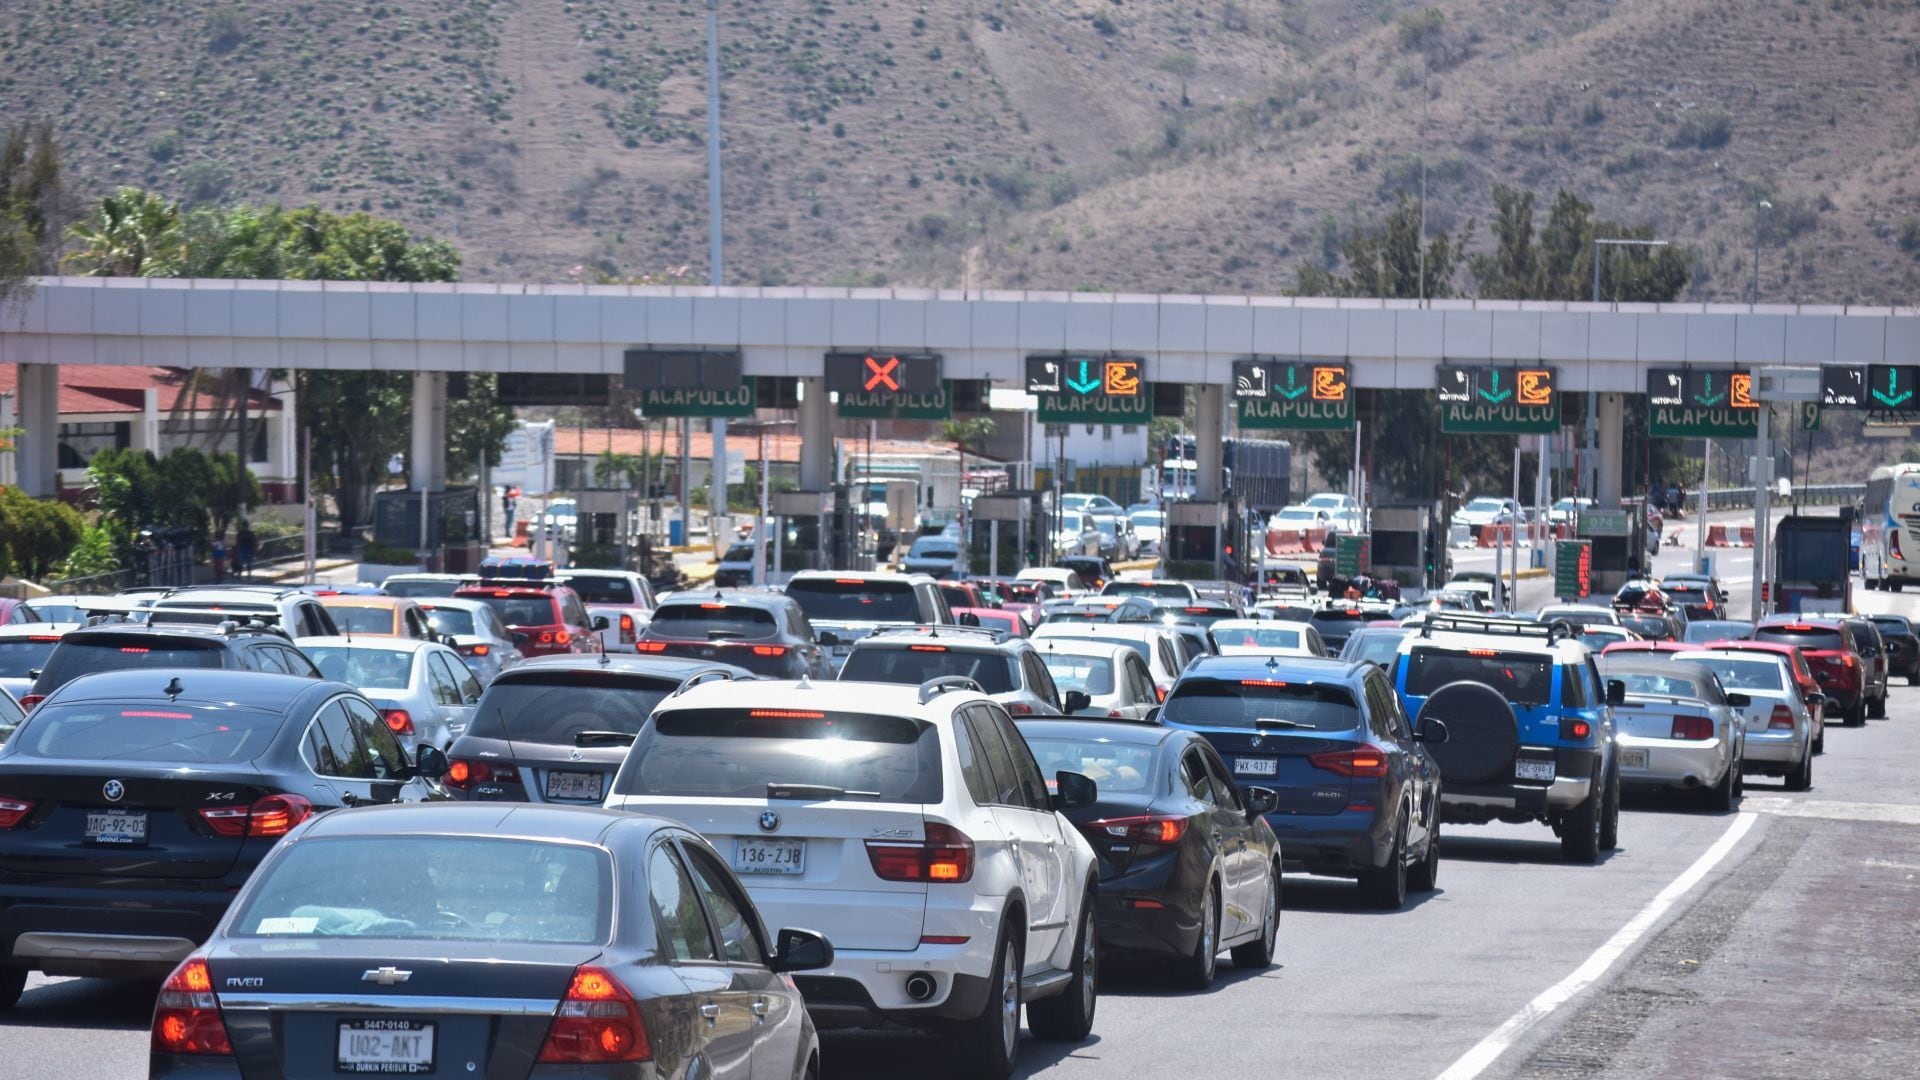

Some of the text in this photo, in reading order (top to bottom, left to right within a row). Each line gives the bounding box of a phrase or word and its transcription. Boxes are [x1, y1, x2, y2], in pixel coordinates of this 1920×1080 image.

[648, 385, 750, 406] ACAPULCO
[844, 389, 946, 408] ACAPULCO
[1045, 395, 1146, 413] ACAPULCO
[1244, 401, 1348, 420] ACAPULCO
[1450, 404, 1554, 421] ACAPULCO
[1806, 403, 1818, 428] 9
[206, 792, 236, 800] X4
[742, 849, 800, 864] 136-ZJB
[226, 977, 264, 987] AVEO
[364, 1020, 410, 1030] 5447-0140
[350, 1035, 423, 1058] U02-AKT
[381, 1063, 407, 1073] PERISUR
